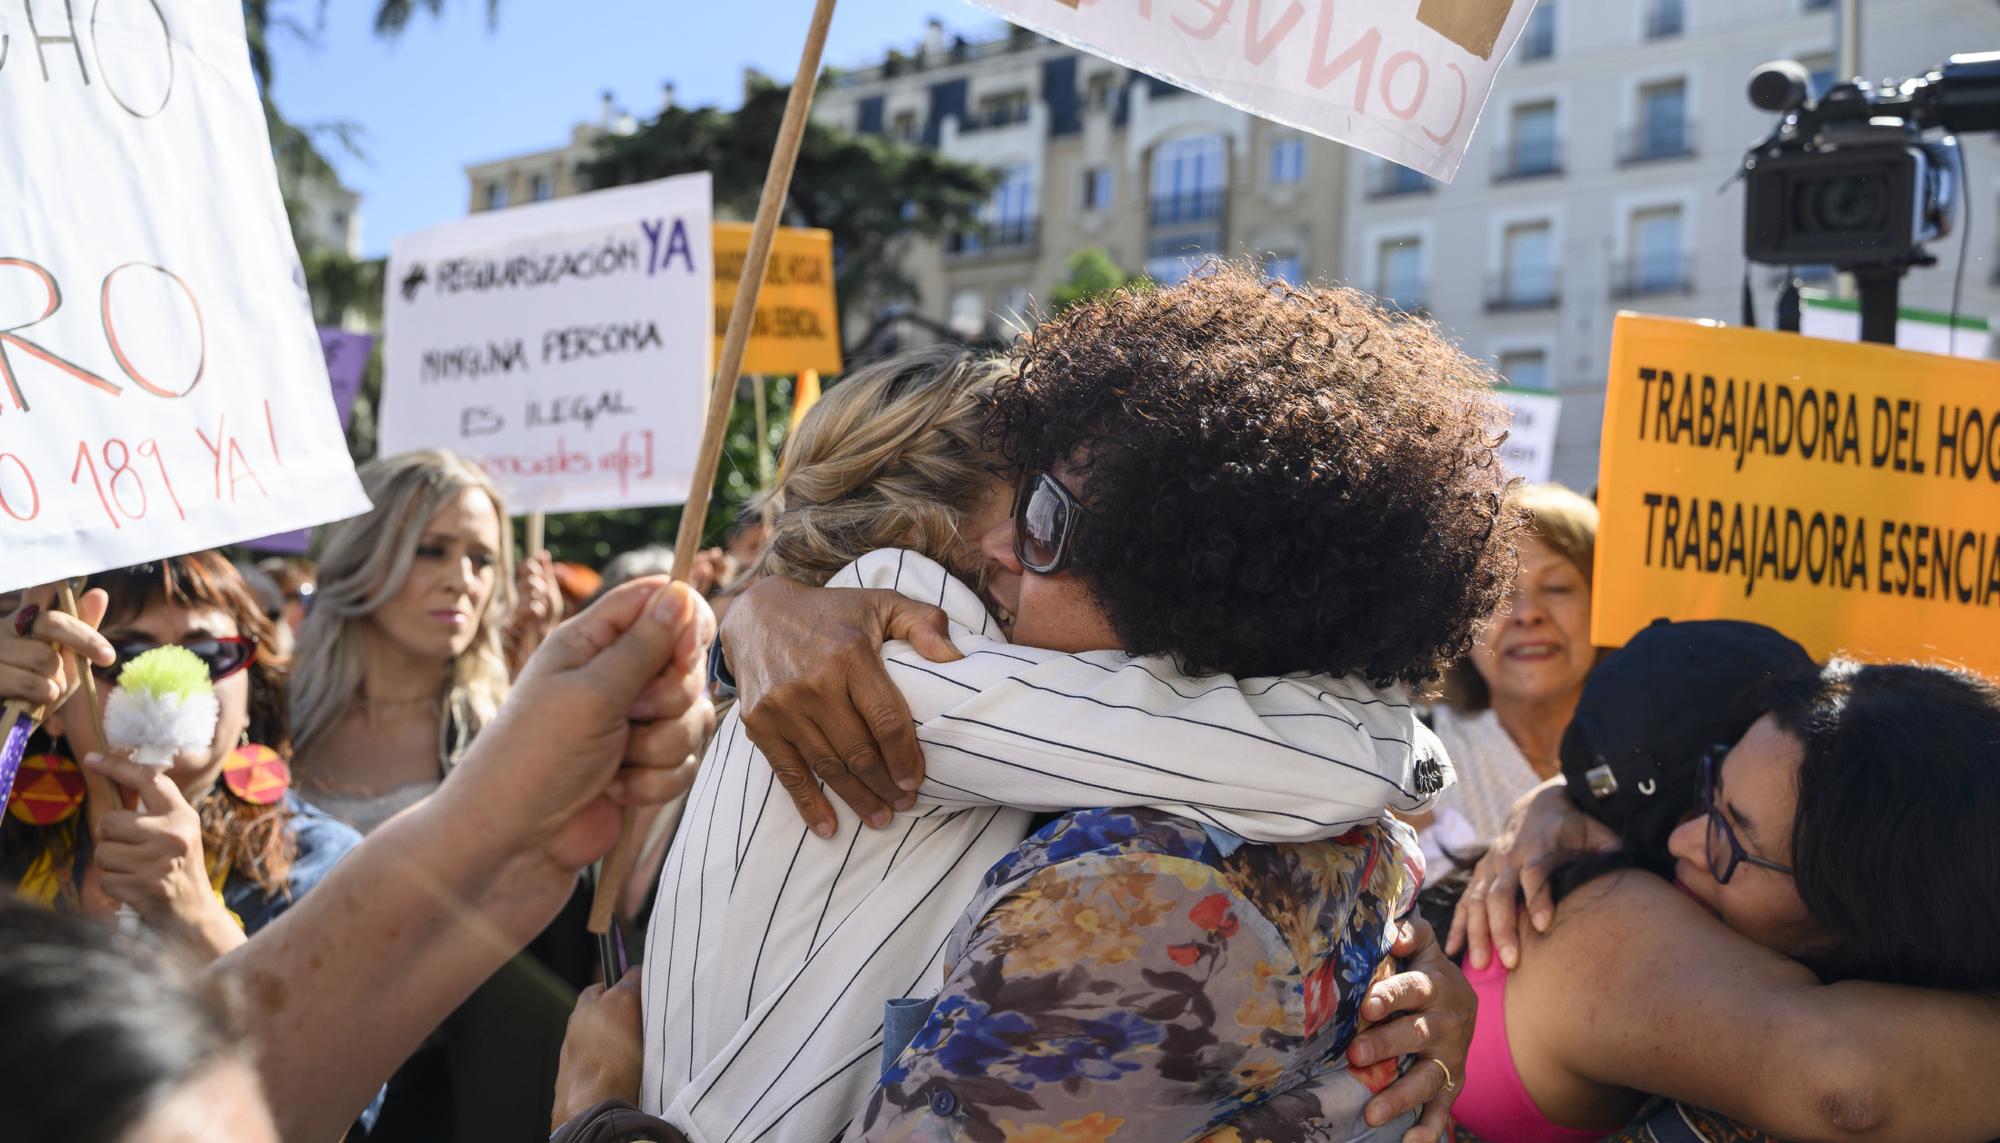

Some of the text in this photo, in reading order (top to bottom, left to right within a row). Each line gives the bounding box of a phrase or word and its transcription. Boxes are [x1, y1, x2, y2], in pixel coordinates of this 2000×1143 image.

[0, 0, 174, 118] HO
[640, 216, 694, 276] YA
[420, 337, 529, 383] NINGUNA
[541, 319, 662, 364] PERSONA
[460, 390, 634, 438] ES ILEGAL
[1638, 366, 1861, 473] TRABAJADORA
[1871, 396, 1926, 475] DEL
[71, 437, 187, 530] 189
[1643, 492, 1869, 598] TRABAJADORA
